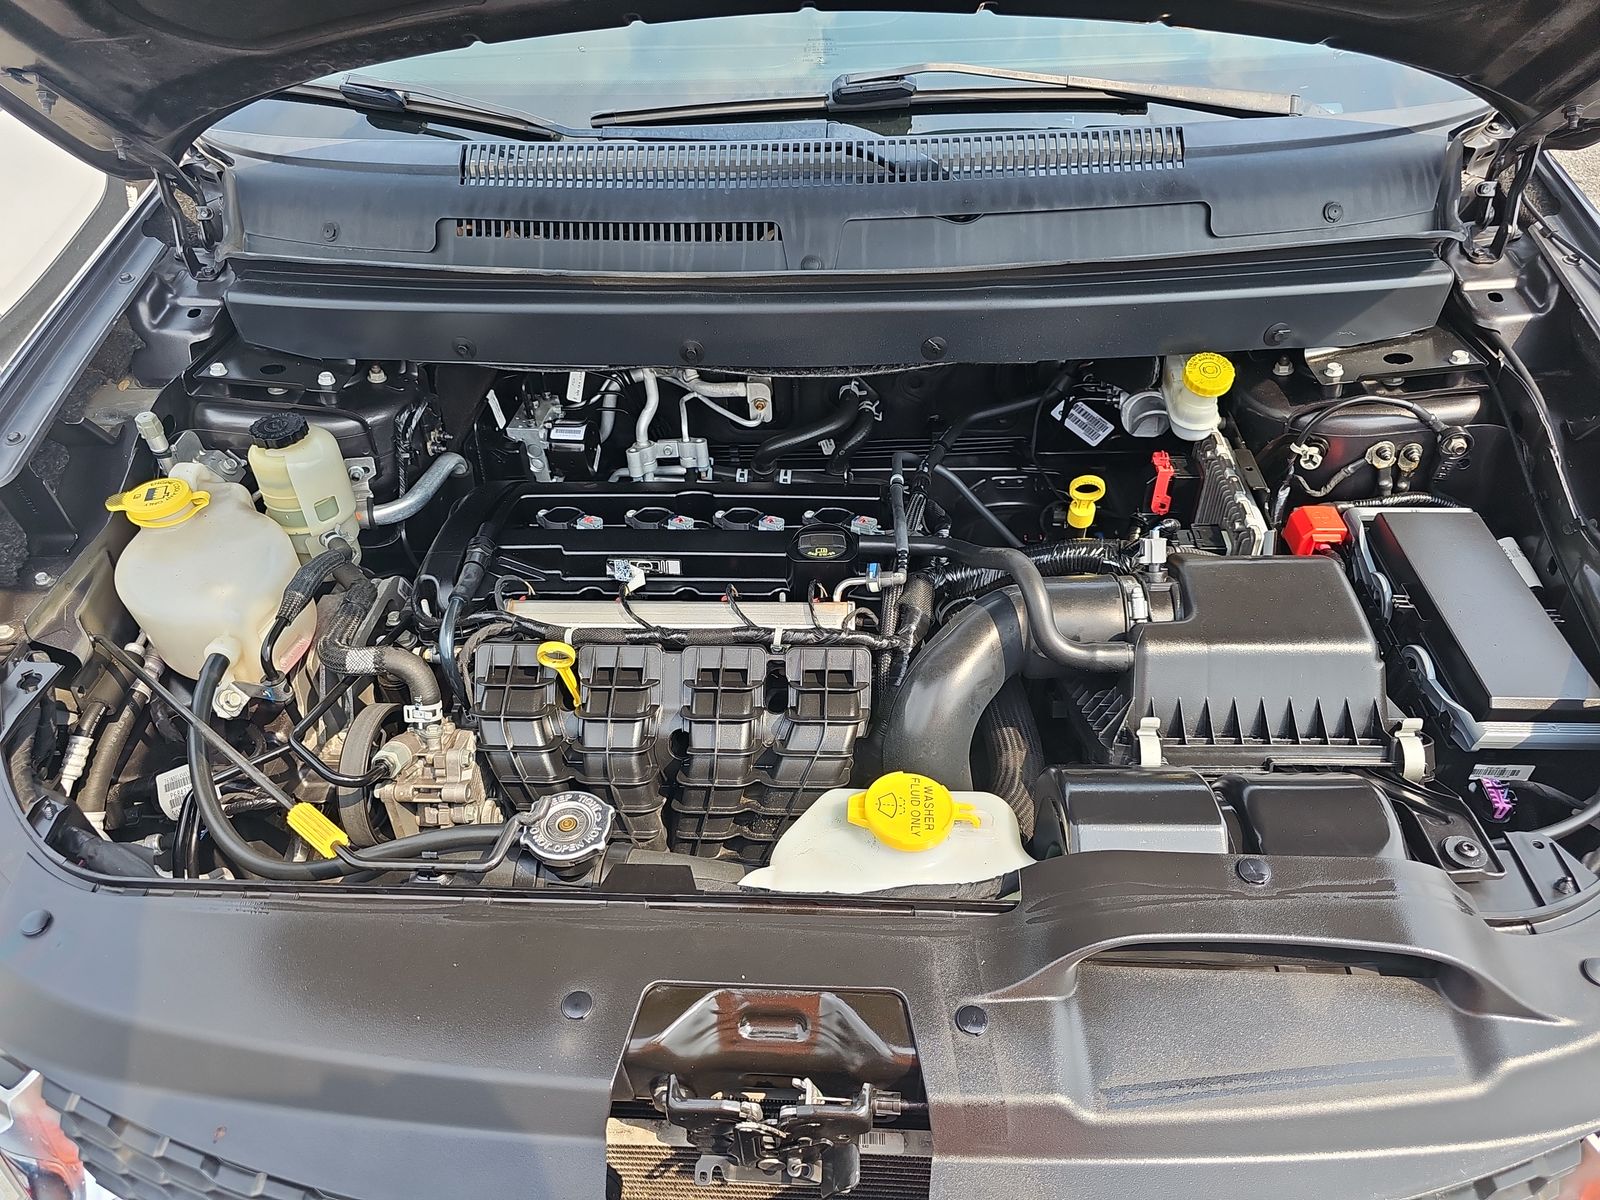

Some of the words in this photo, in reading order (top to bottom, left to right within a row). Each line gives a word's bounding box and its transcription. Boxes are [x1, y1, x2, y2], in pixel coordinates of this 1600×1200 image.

[910, 777, 921, 807] FLUID
[923, 785, 935, 831] WASHER
[910, 809, 921, 837] ONLY
[553, 840, 585, 853] OPEN
[583, 826, 603, 844] HOT
